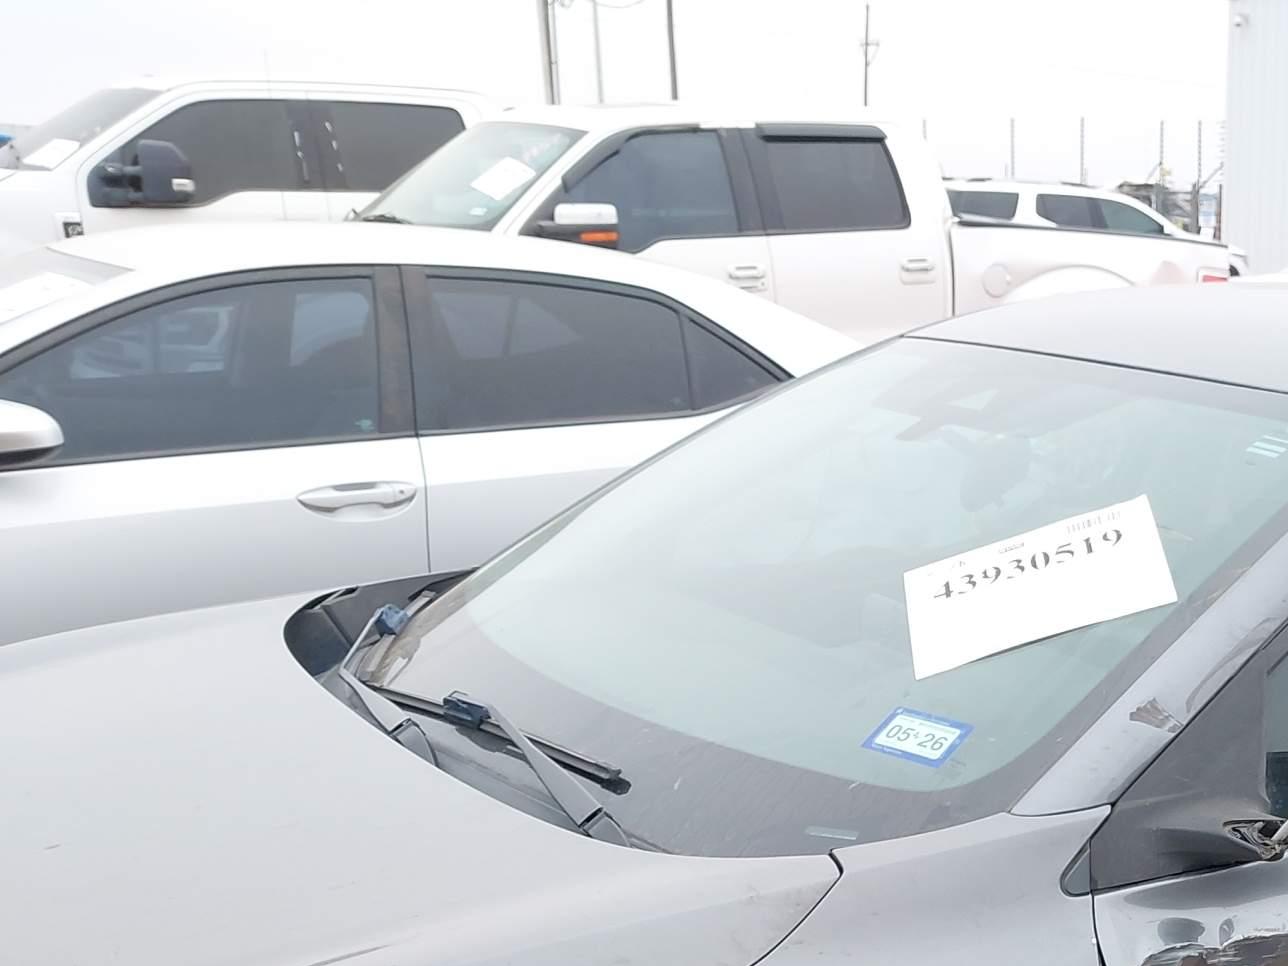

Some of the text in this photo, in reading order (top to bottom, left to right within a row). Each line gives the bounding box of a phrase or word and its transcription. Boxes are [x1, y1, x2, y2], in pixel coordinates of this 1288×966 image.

[932, 529, 1124, 600] 43930519
[886, 724, 916, 742] 05
[916, 732, 949, 751] 26
